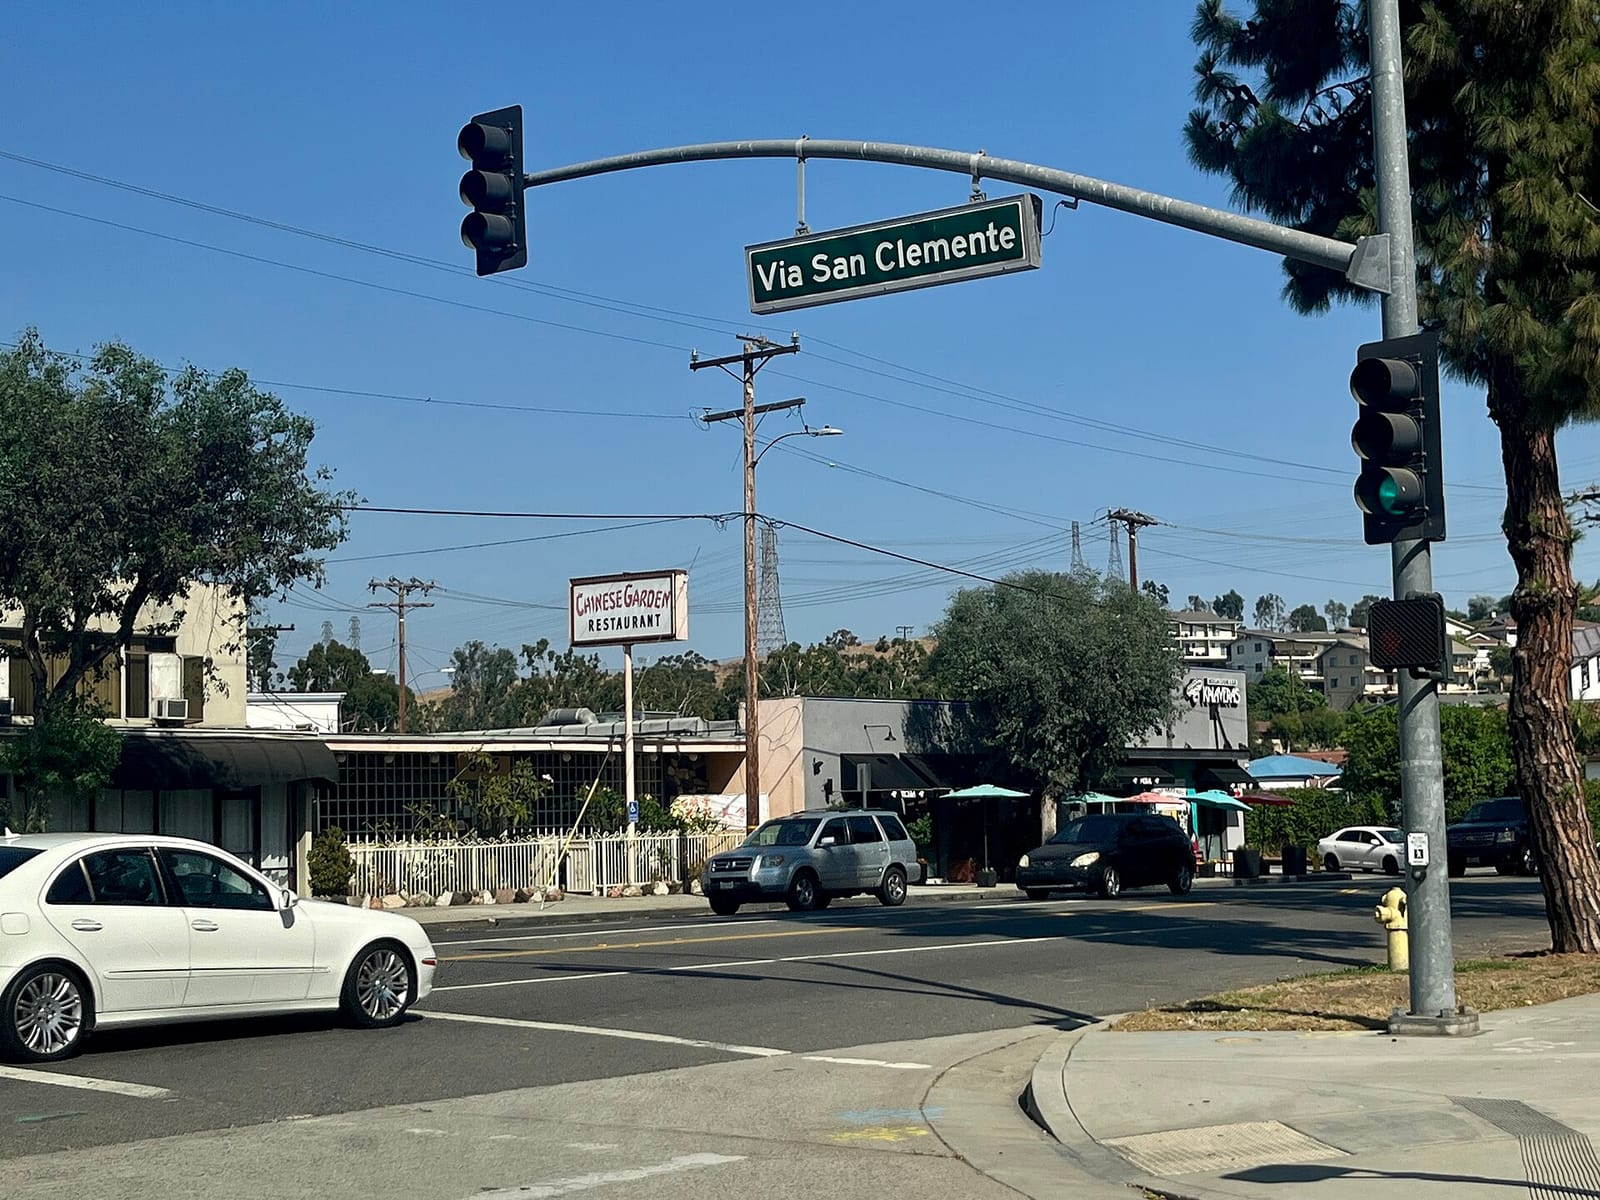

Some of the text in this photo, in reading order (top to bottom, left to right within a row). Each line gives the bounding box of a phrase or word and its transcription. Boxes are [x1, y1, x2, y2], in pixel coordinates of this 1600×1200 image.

[756, 221, 1016, 291] Via San Clemente
[576, 584, 671, 616] CHINESE GARDEN
[588, 613, 661, 632] RESTAURANT
